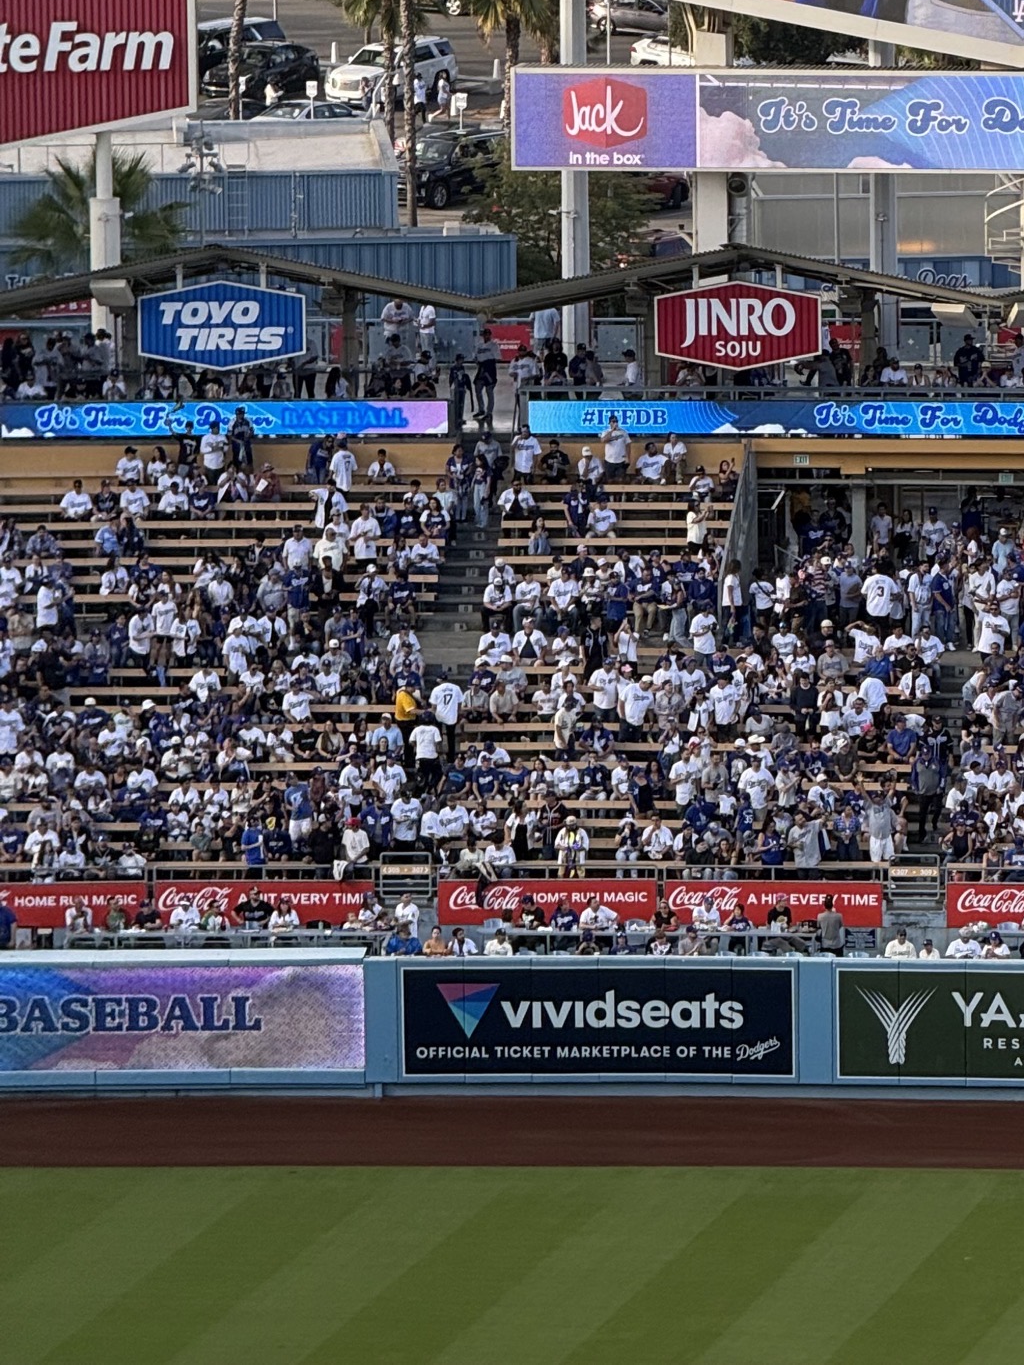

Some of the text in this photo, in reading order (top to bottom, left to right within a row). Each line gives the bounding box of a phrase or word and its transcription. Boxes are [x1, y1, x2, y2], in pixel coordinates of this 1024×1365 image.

[43, 21, 175, 73] Farm
[565, 85, 645, 137] Jack
[758, 96, 817, 133] It's
[822, 97, 897, 135] Time
[906, 98, 969, 137] For
[569, 151, 642, 165] in the box
[159, 300, 261, 326] TOYO
[680, 297, 797, 349] JINRO
[176, 326, 285, 351] TIRES
[715, 340, 762, 359] SOJU
[35, 403, 80, 432] It's
[82, 403, 136, 431] Time
[195, 402, 276, 432] Doer
[282, 406, 410, 429] BASEBALL
[581, 407, 669, 427] #ITFDB
[814, 402, 856, 428] It's
[860, 402, 912, 428] Time
[918, 404, 963, 429] For
[877, 586, 884, 597] 3
[443, 693, 453, 706] 17
[14, 895, 56, 907] HOME
[572, 892, 599, 903] RUN
[603, 891, 648, 903] MAGIC
[668, 885, 742, 910] Coca-Cola
[747, 893, 757, 905] A
[842, 894, 879, 906] TIME
[0, 994, 263, 1034] BASEBALL
[501, 989, 745, 1030] vividseats
[416, 1036, 781, 1062] OFFICIAL TICKET MARKETPLACE OF THE Dodgers
